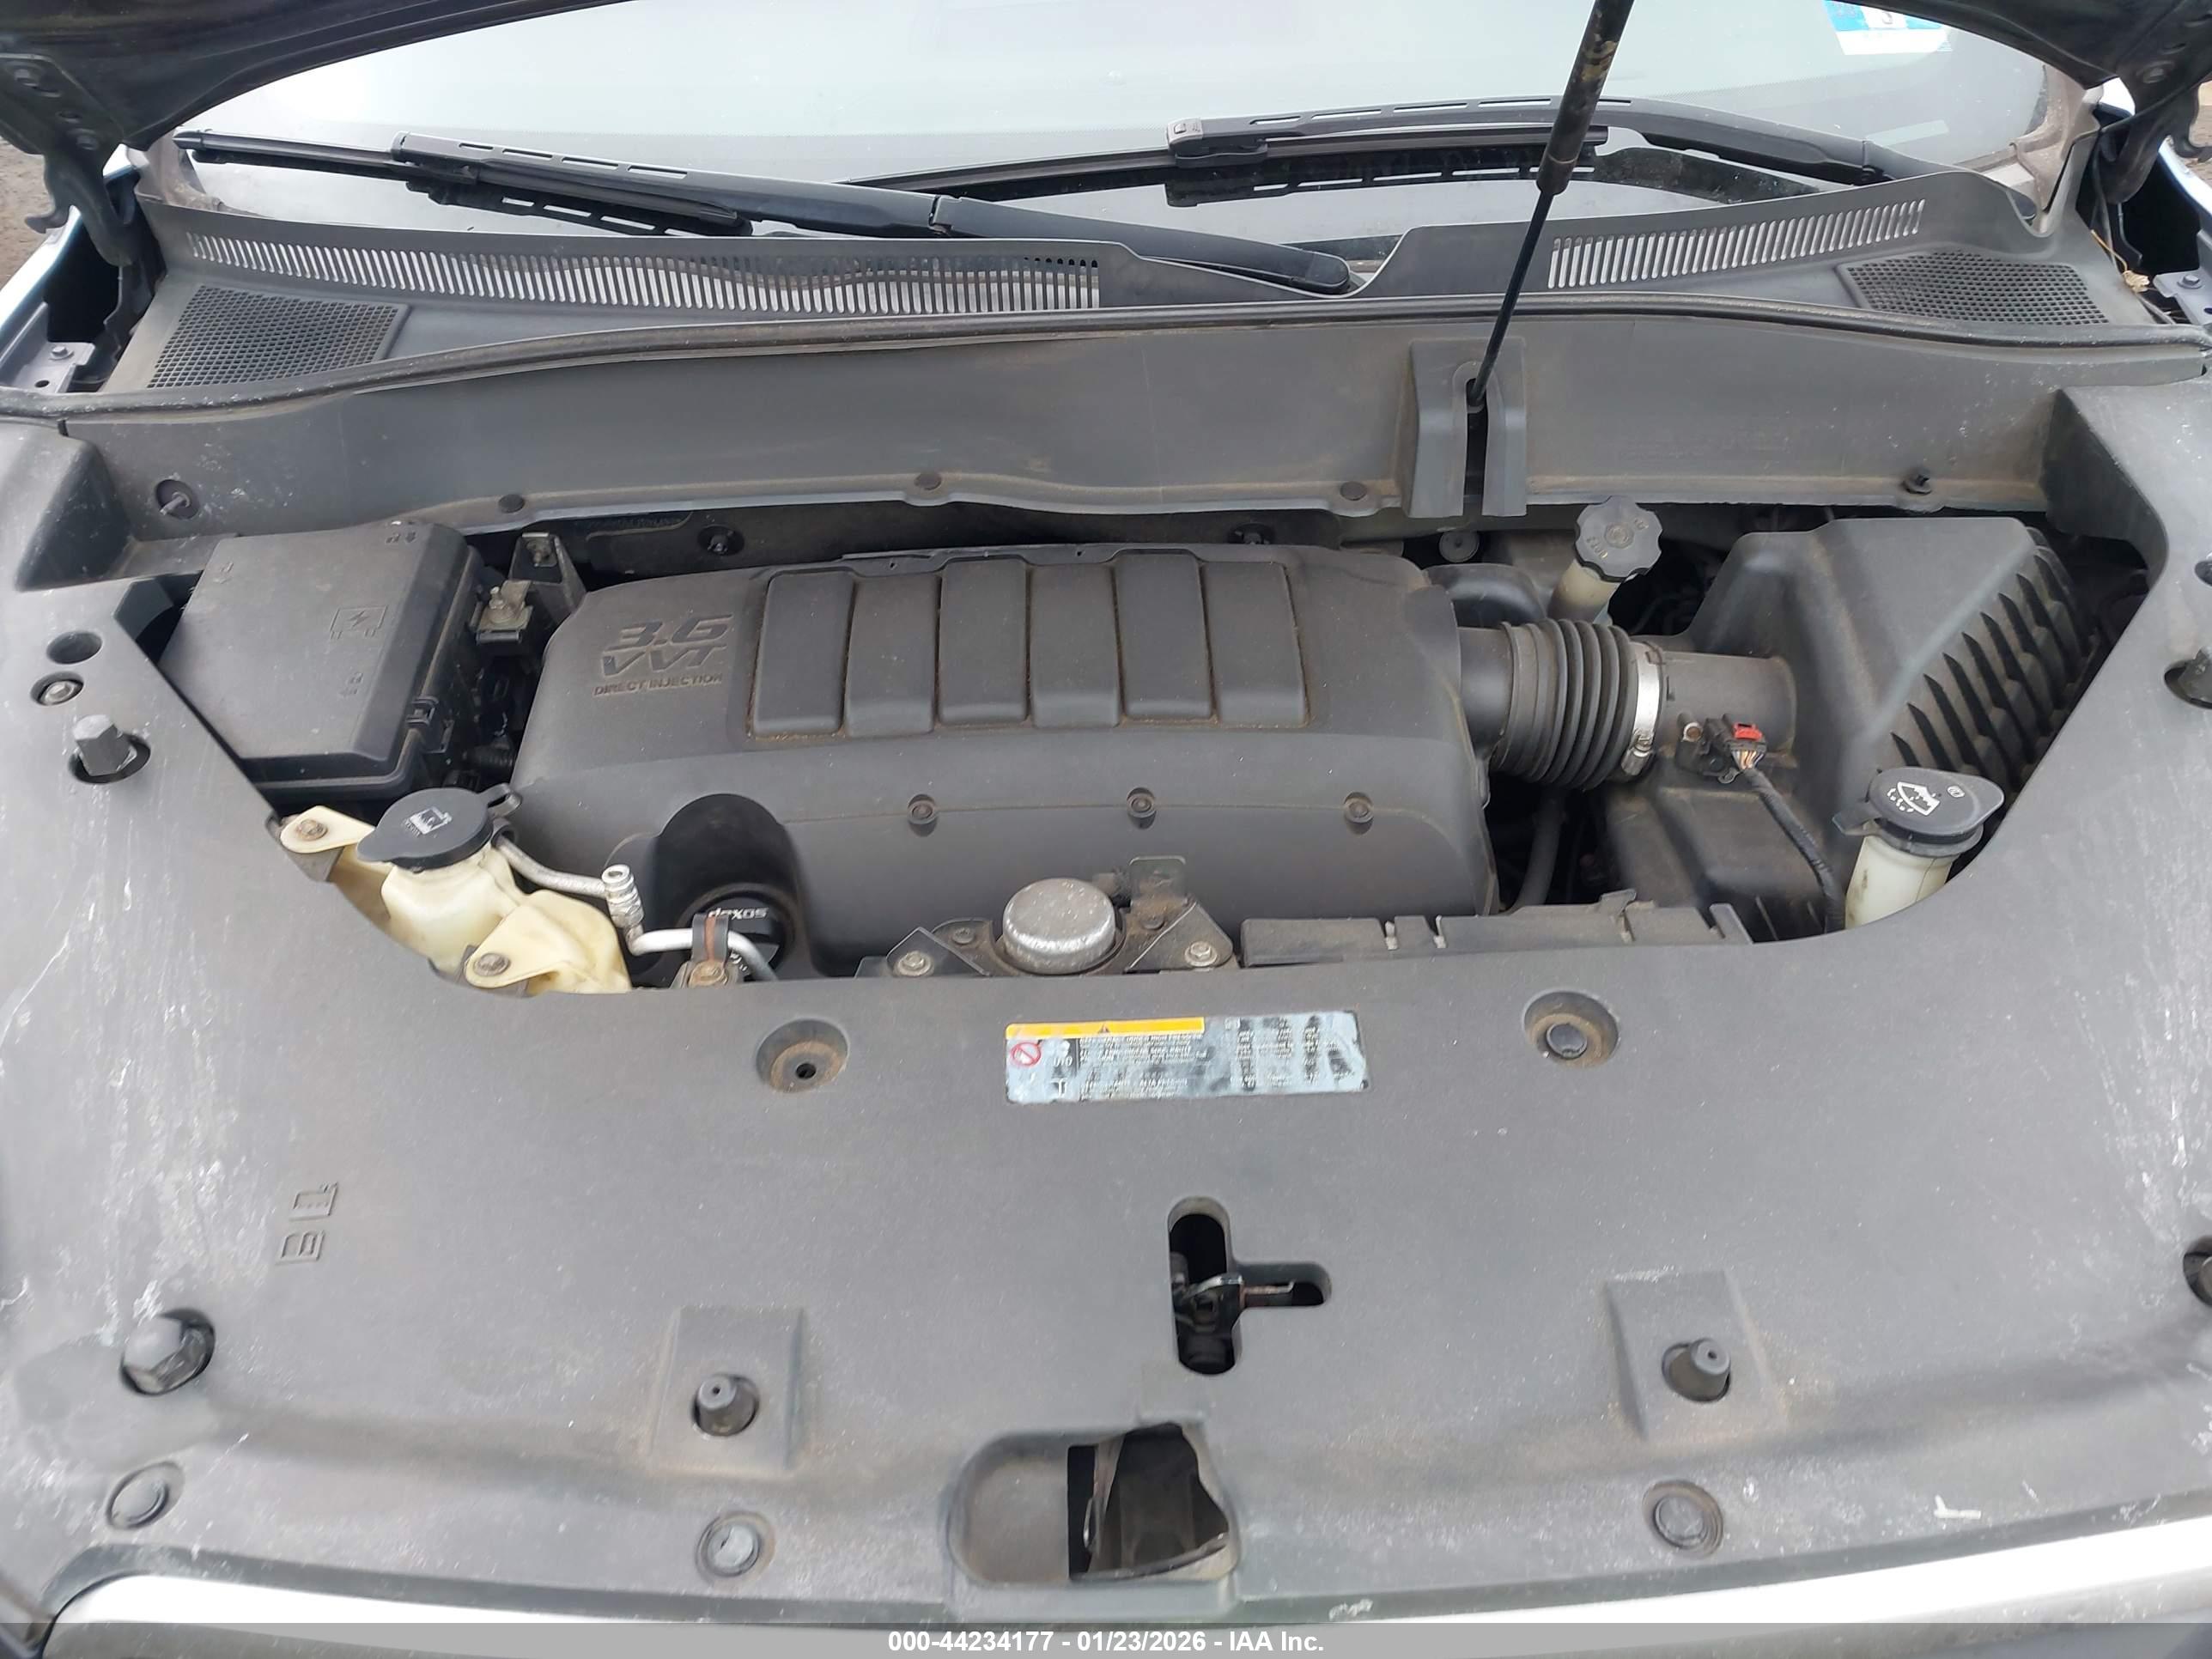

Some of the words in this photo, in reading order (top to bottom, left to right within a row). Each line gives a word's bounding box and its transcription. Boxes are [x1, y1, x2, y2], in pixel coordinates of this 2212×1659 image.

[603, 613, 733, 653] 3.6
[601, 644, 727, 678] VVT
[592, 679, 647, 697] DIRECT
[647, 673, 723, 690] INJECTION
